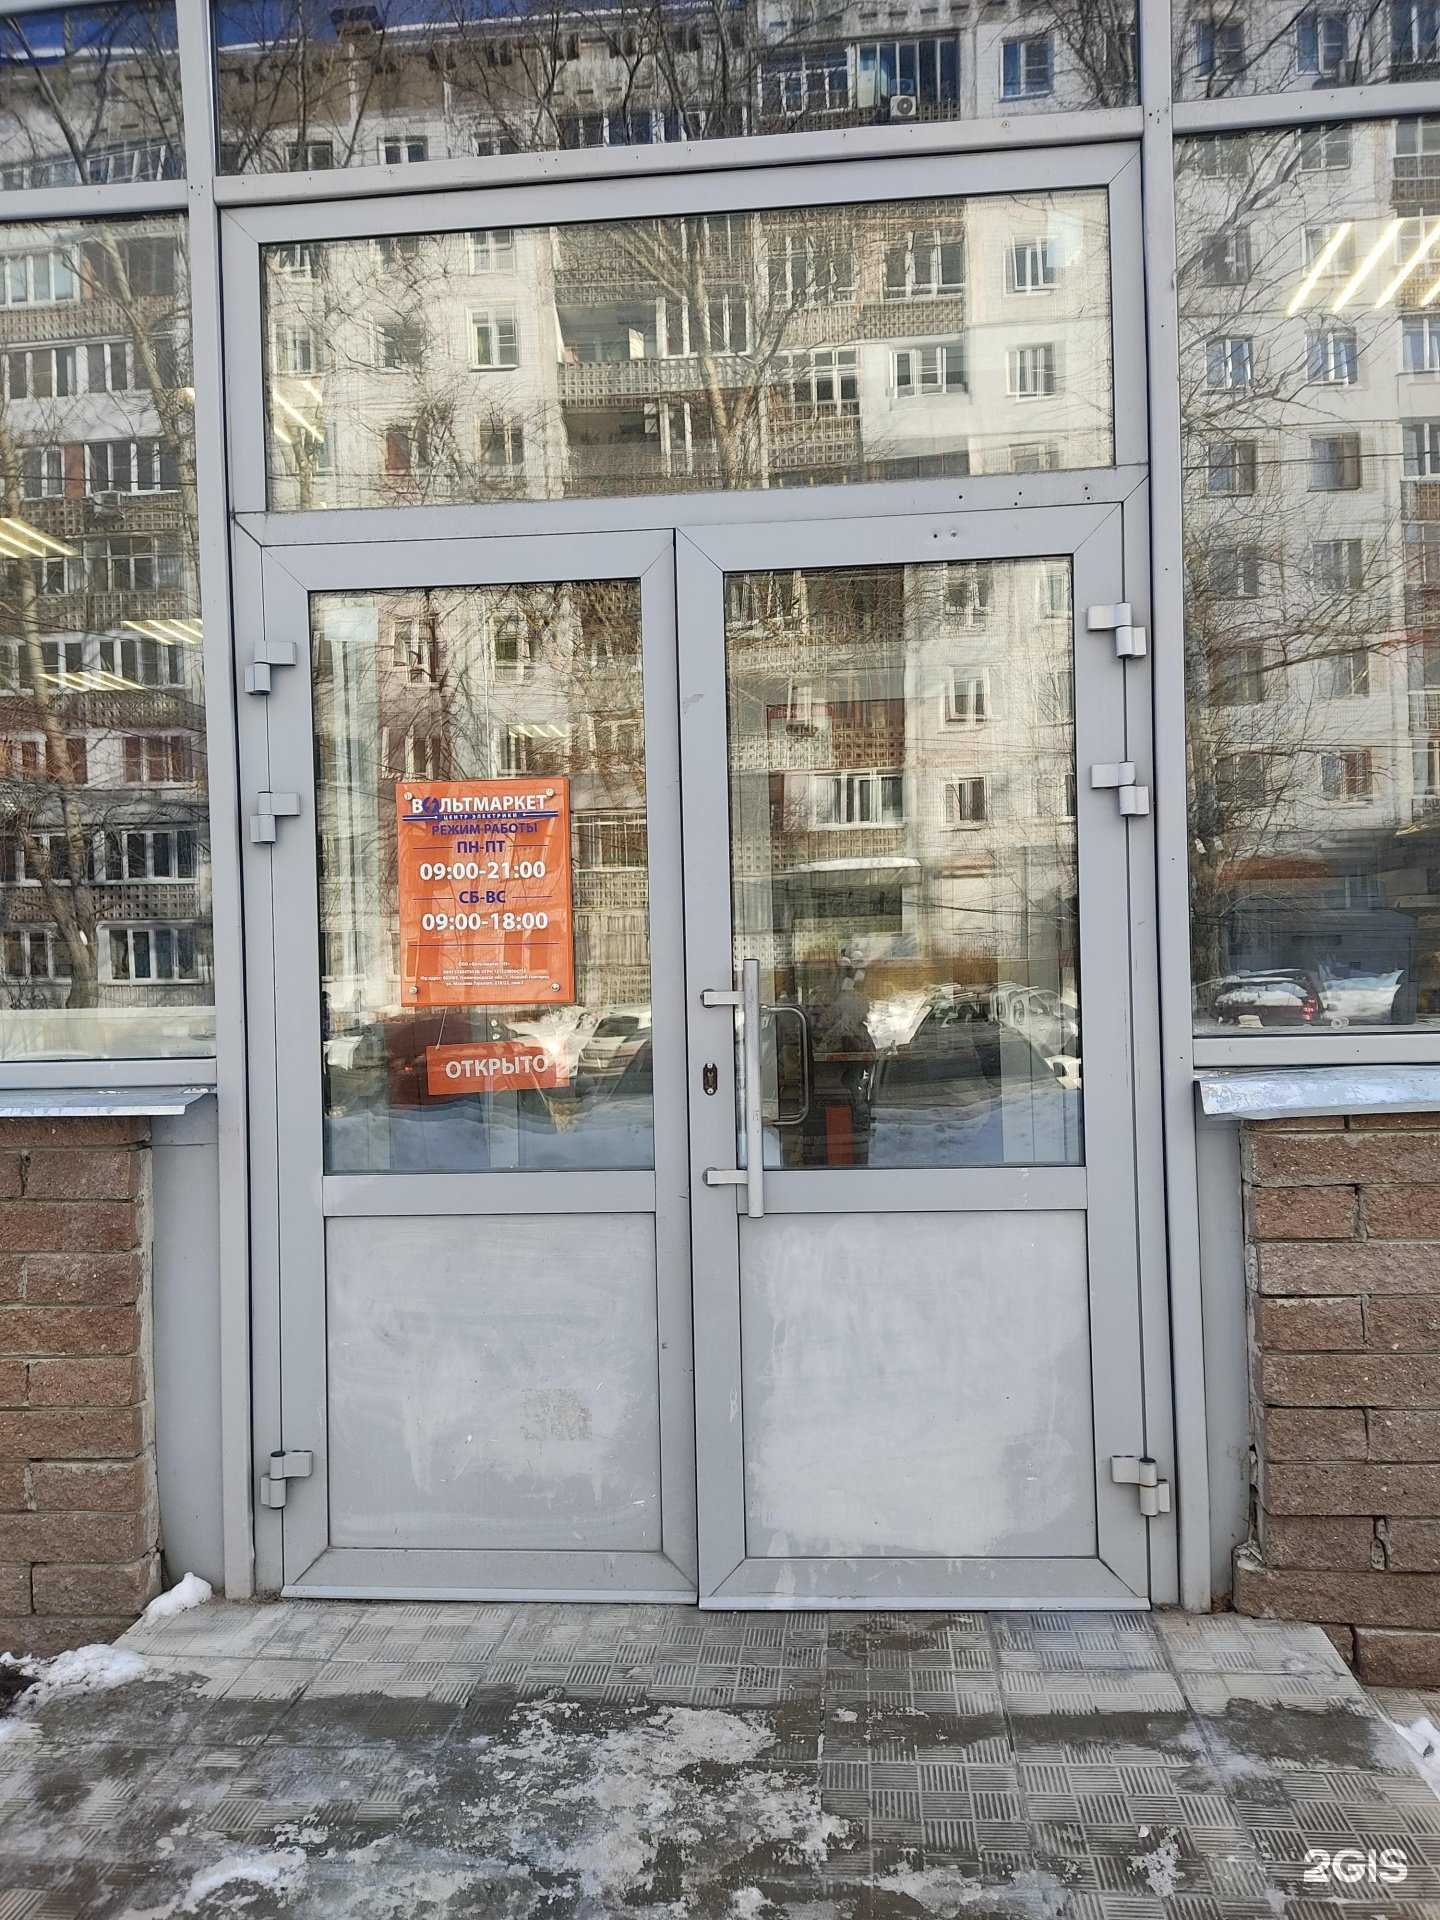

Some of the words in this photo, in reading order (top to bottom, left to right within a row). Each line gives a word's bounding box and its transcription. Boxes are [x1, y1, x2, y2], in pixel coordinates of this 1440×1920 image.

[411, 794, 547, 815] ВОЛЬТМАРКЕТ
[432, 824, 480, 836] РЕЖИМ
[484, 822, 538, 835] РАБОТЫ
[457, 840, 505, 853] ПН-ПТ
[419, 861, 546, 880] 09:00-21:00
[459, 890, 506, 904] СБ-ВС
[422, 912, 548, 932] 09:00-18:00
[445, 1054, 549, 1079] ОТКРЫТО
